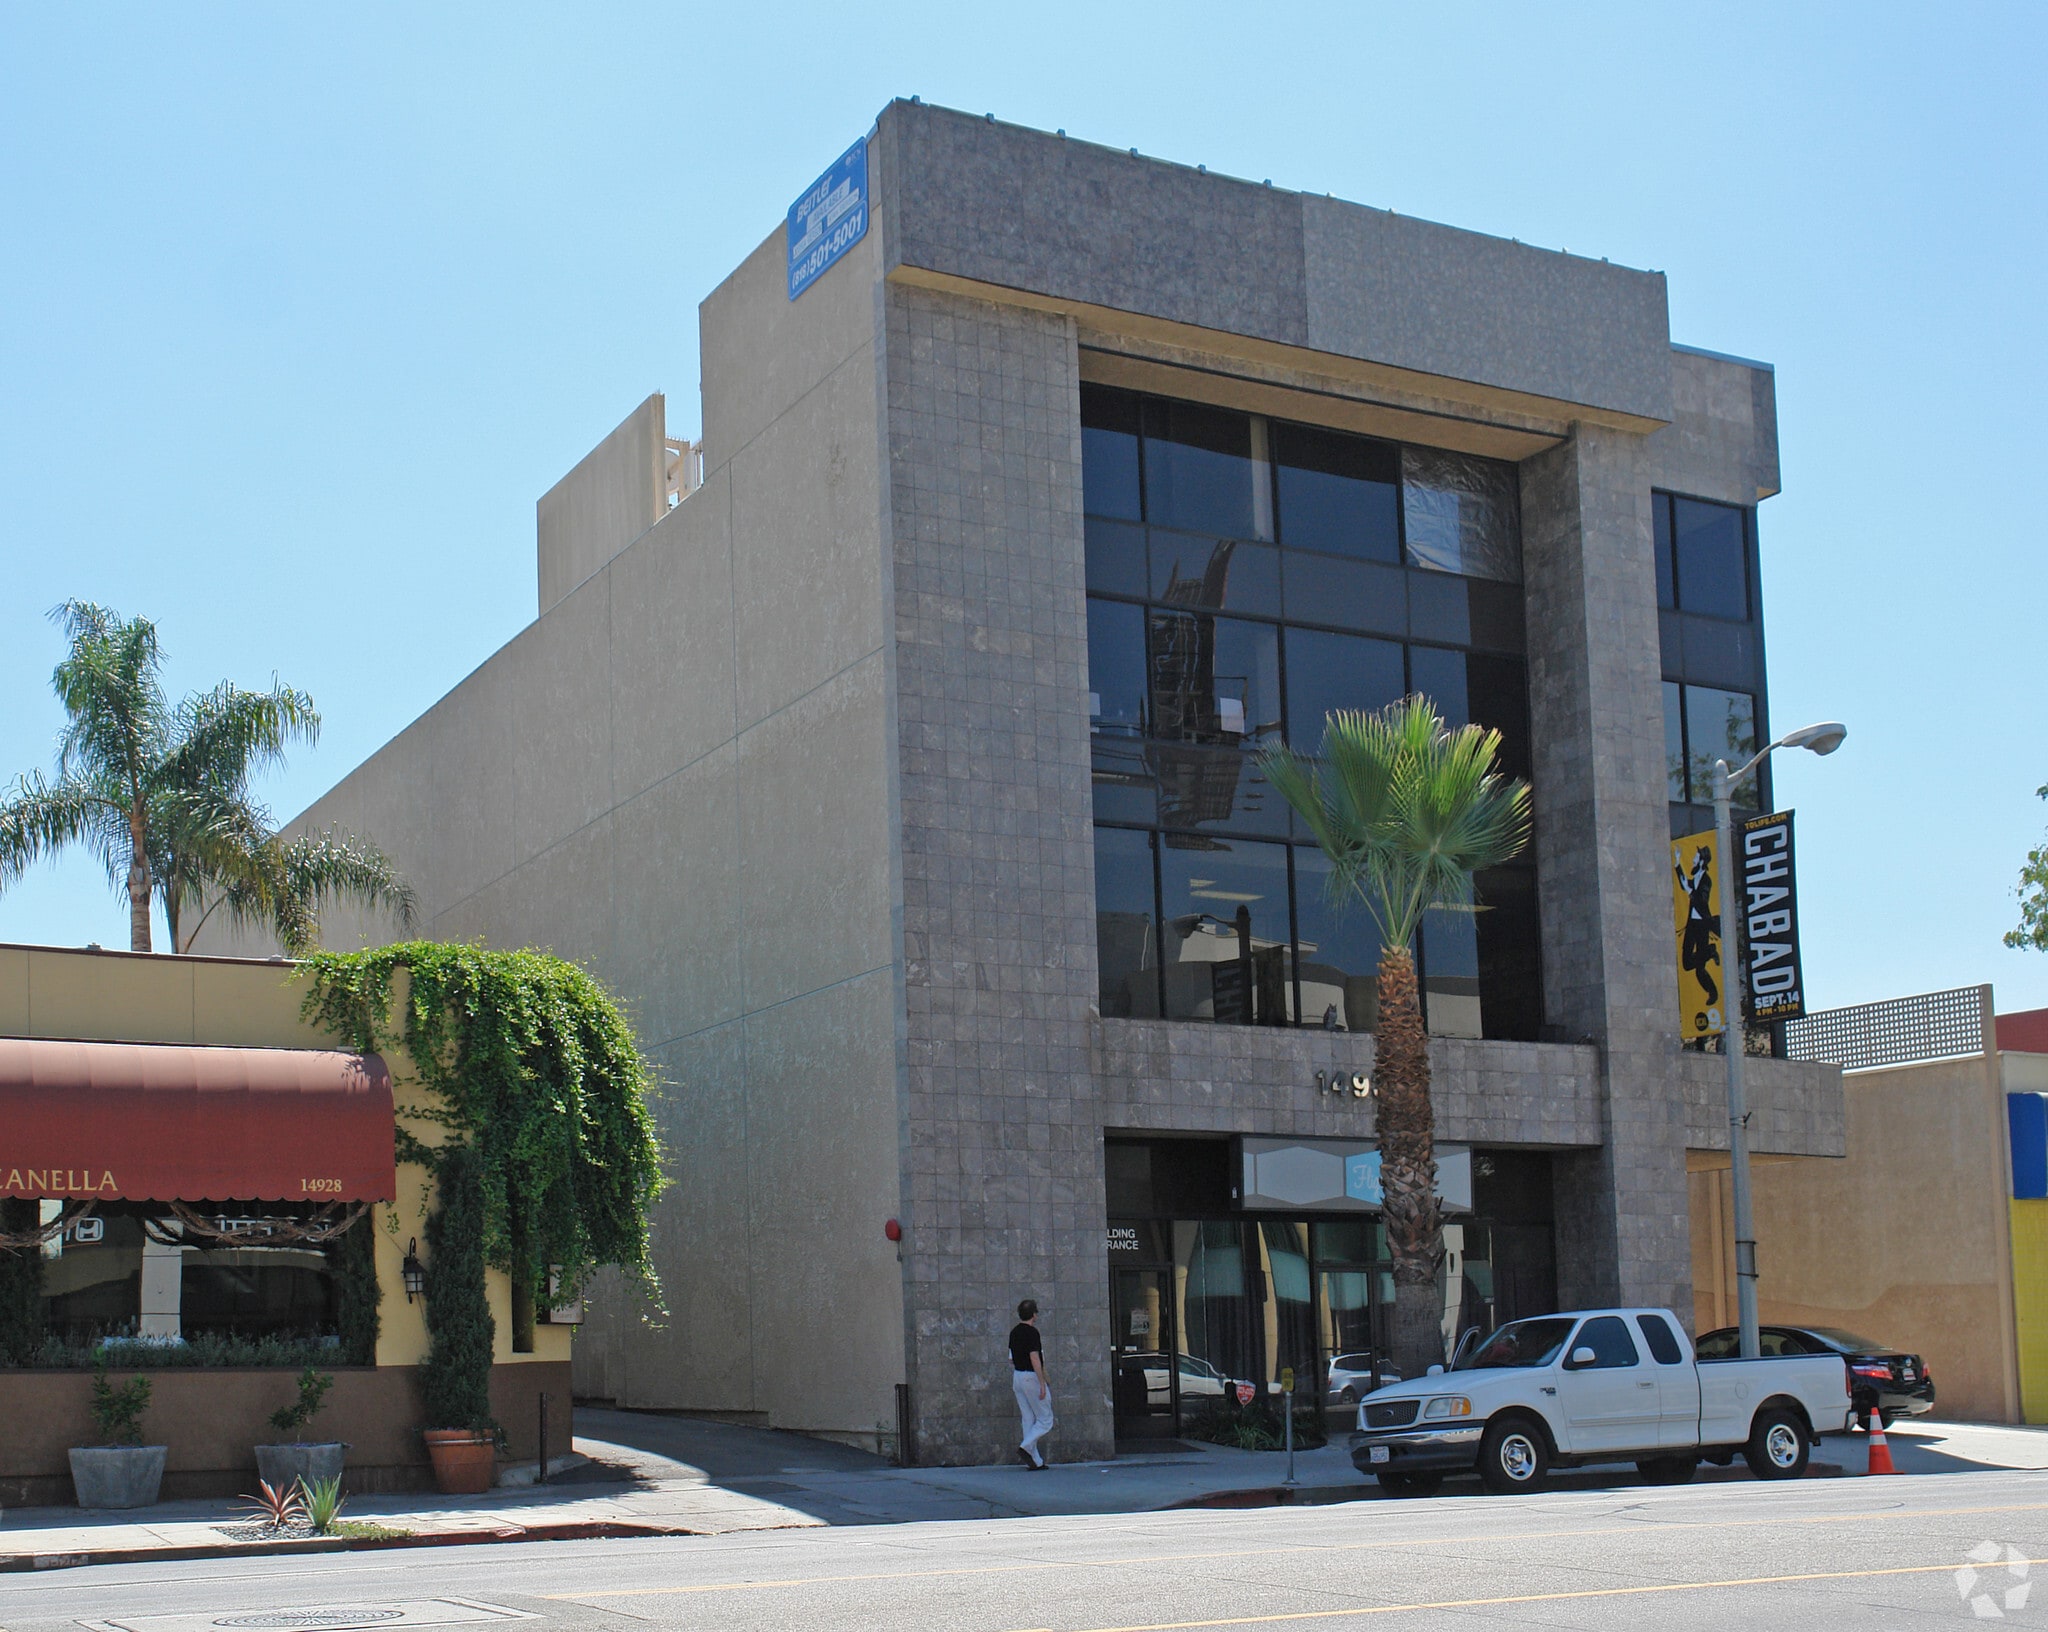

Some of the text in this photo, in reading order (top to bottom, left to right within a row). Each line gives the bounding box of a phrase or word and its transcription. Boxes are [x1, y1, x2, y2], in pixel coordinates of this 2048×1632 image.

[1744, 825, 1795, 994] CHABAD
[1317, 1070, 1379, 1098] 149
[0, 1168, 118, 1192] ANELLA
[301, 1179, 342, 1193] 14928
